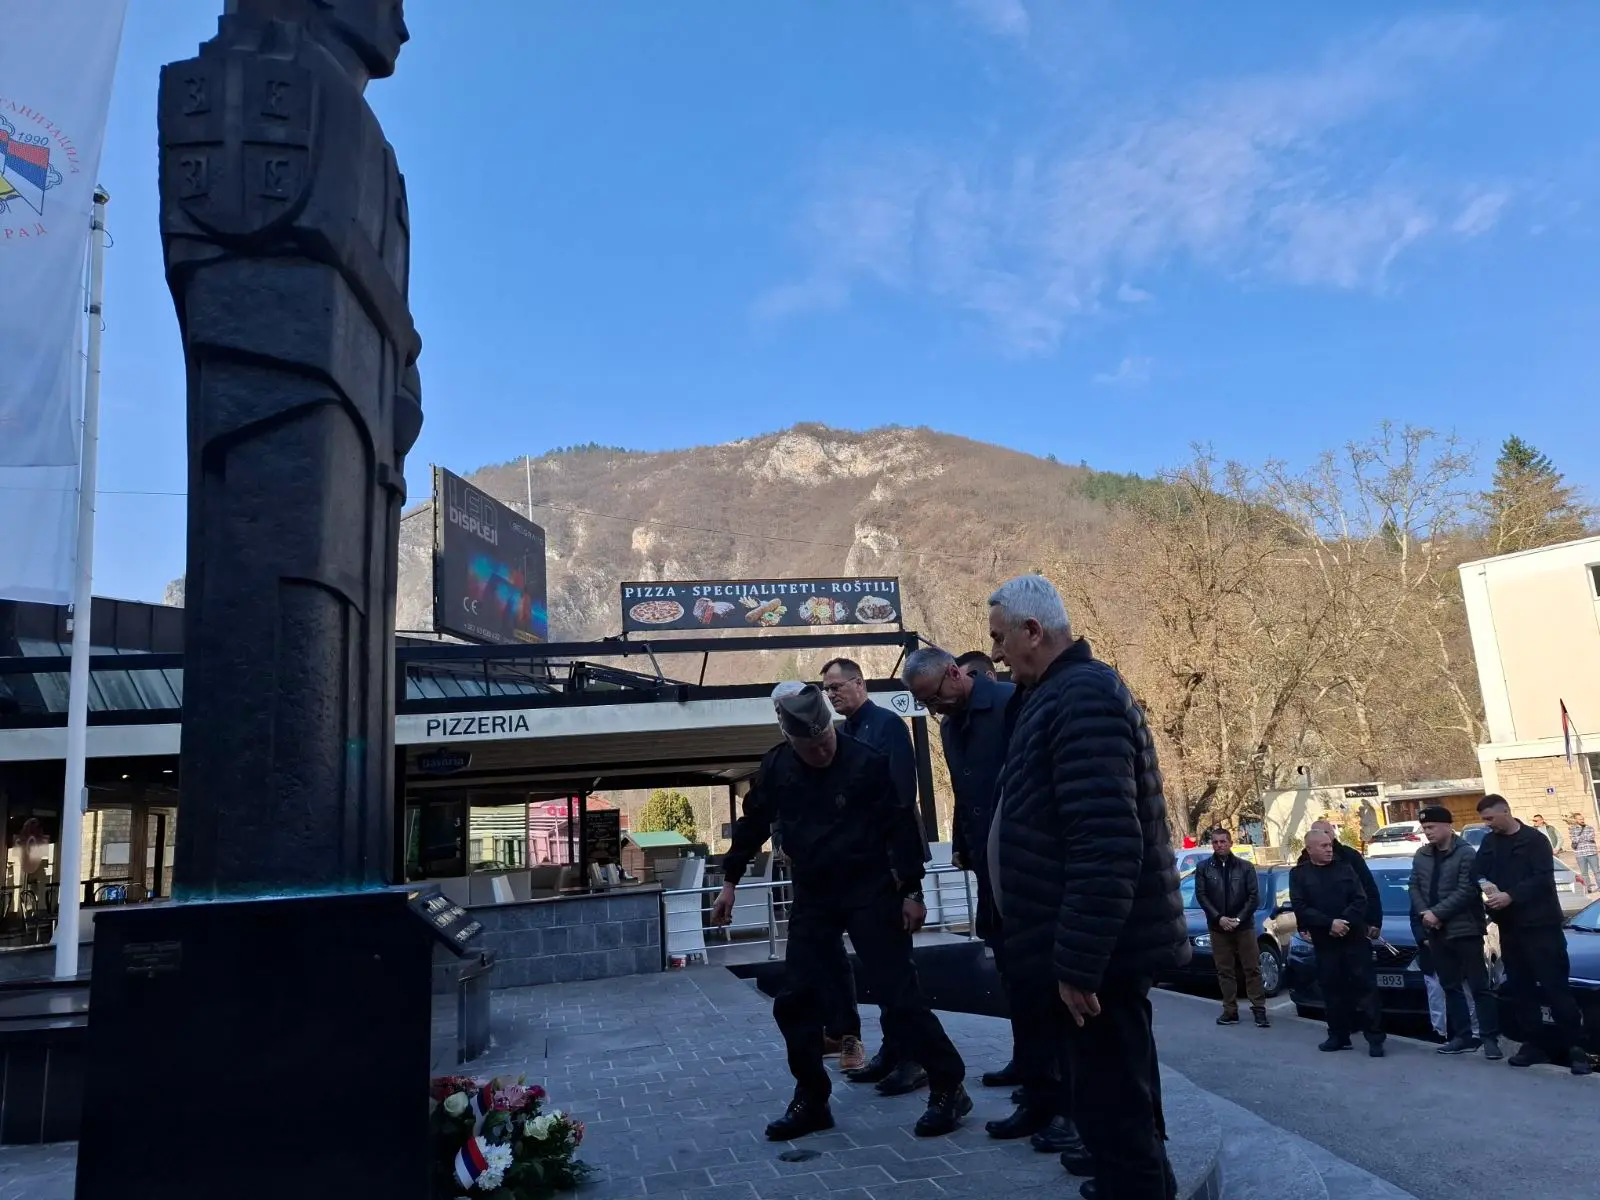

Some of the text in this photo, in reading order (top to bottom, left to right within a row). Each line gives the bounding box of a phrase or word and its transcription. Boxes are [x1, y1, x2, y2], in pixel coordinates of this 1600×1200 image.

[18, 132, 49, 146] 1990
[448, 477, 498, 528] LED
[449, 504, 498, 546] DISPLEJI
[625, 586, 676, 598] PIZZA
[692, 583, 816, 597] SPECIJALITETI
[831, 580, 895, 593] ROŠTILJ
[426, 714, 530, 737] PIZZERIA
